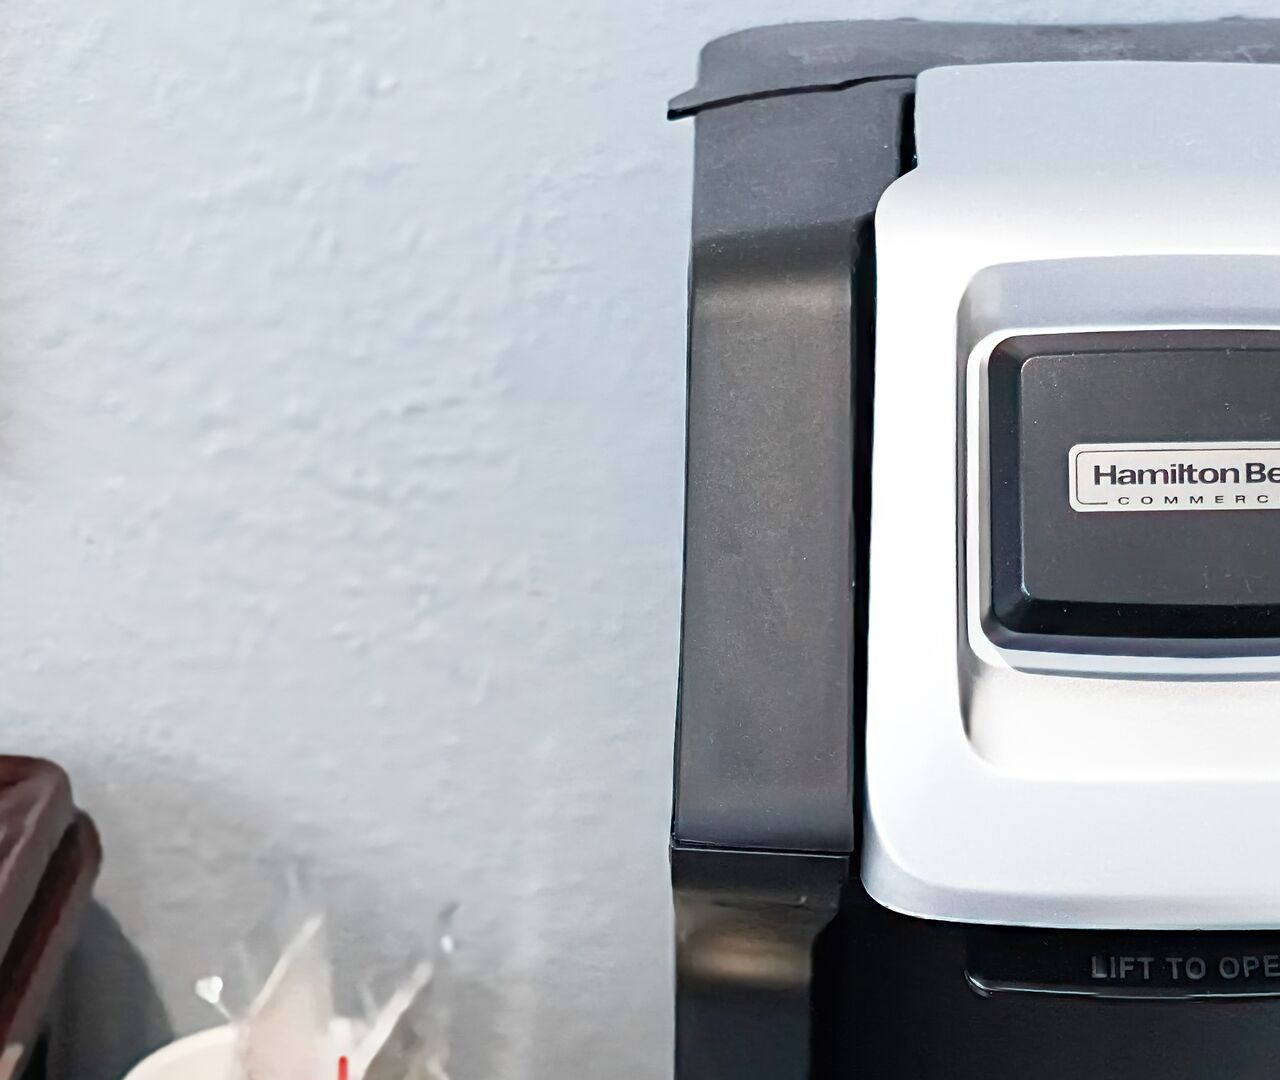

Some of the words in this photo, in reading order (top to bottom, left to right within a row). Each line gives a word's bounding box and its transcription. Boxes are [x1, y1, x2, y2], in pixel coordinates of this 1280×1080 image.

[1093, 463, 1240, 485] Hamilton
[1091, 955, 1155, 979] LIFT
[1167, 956, 1207, 979] TO
